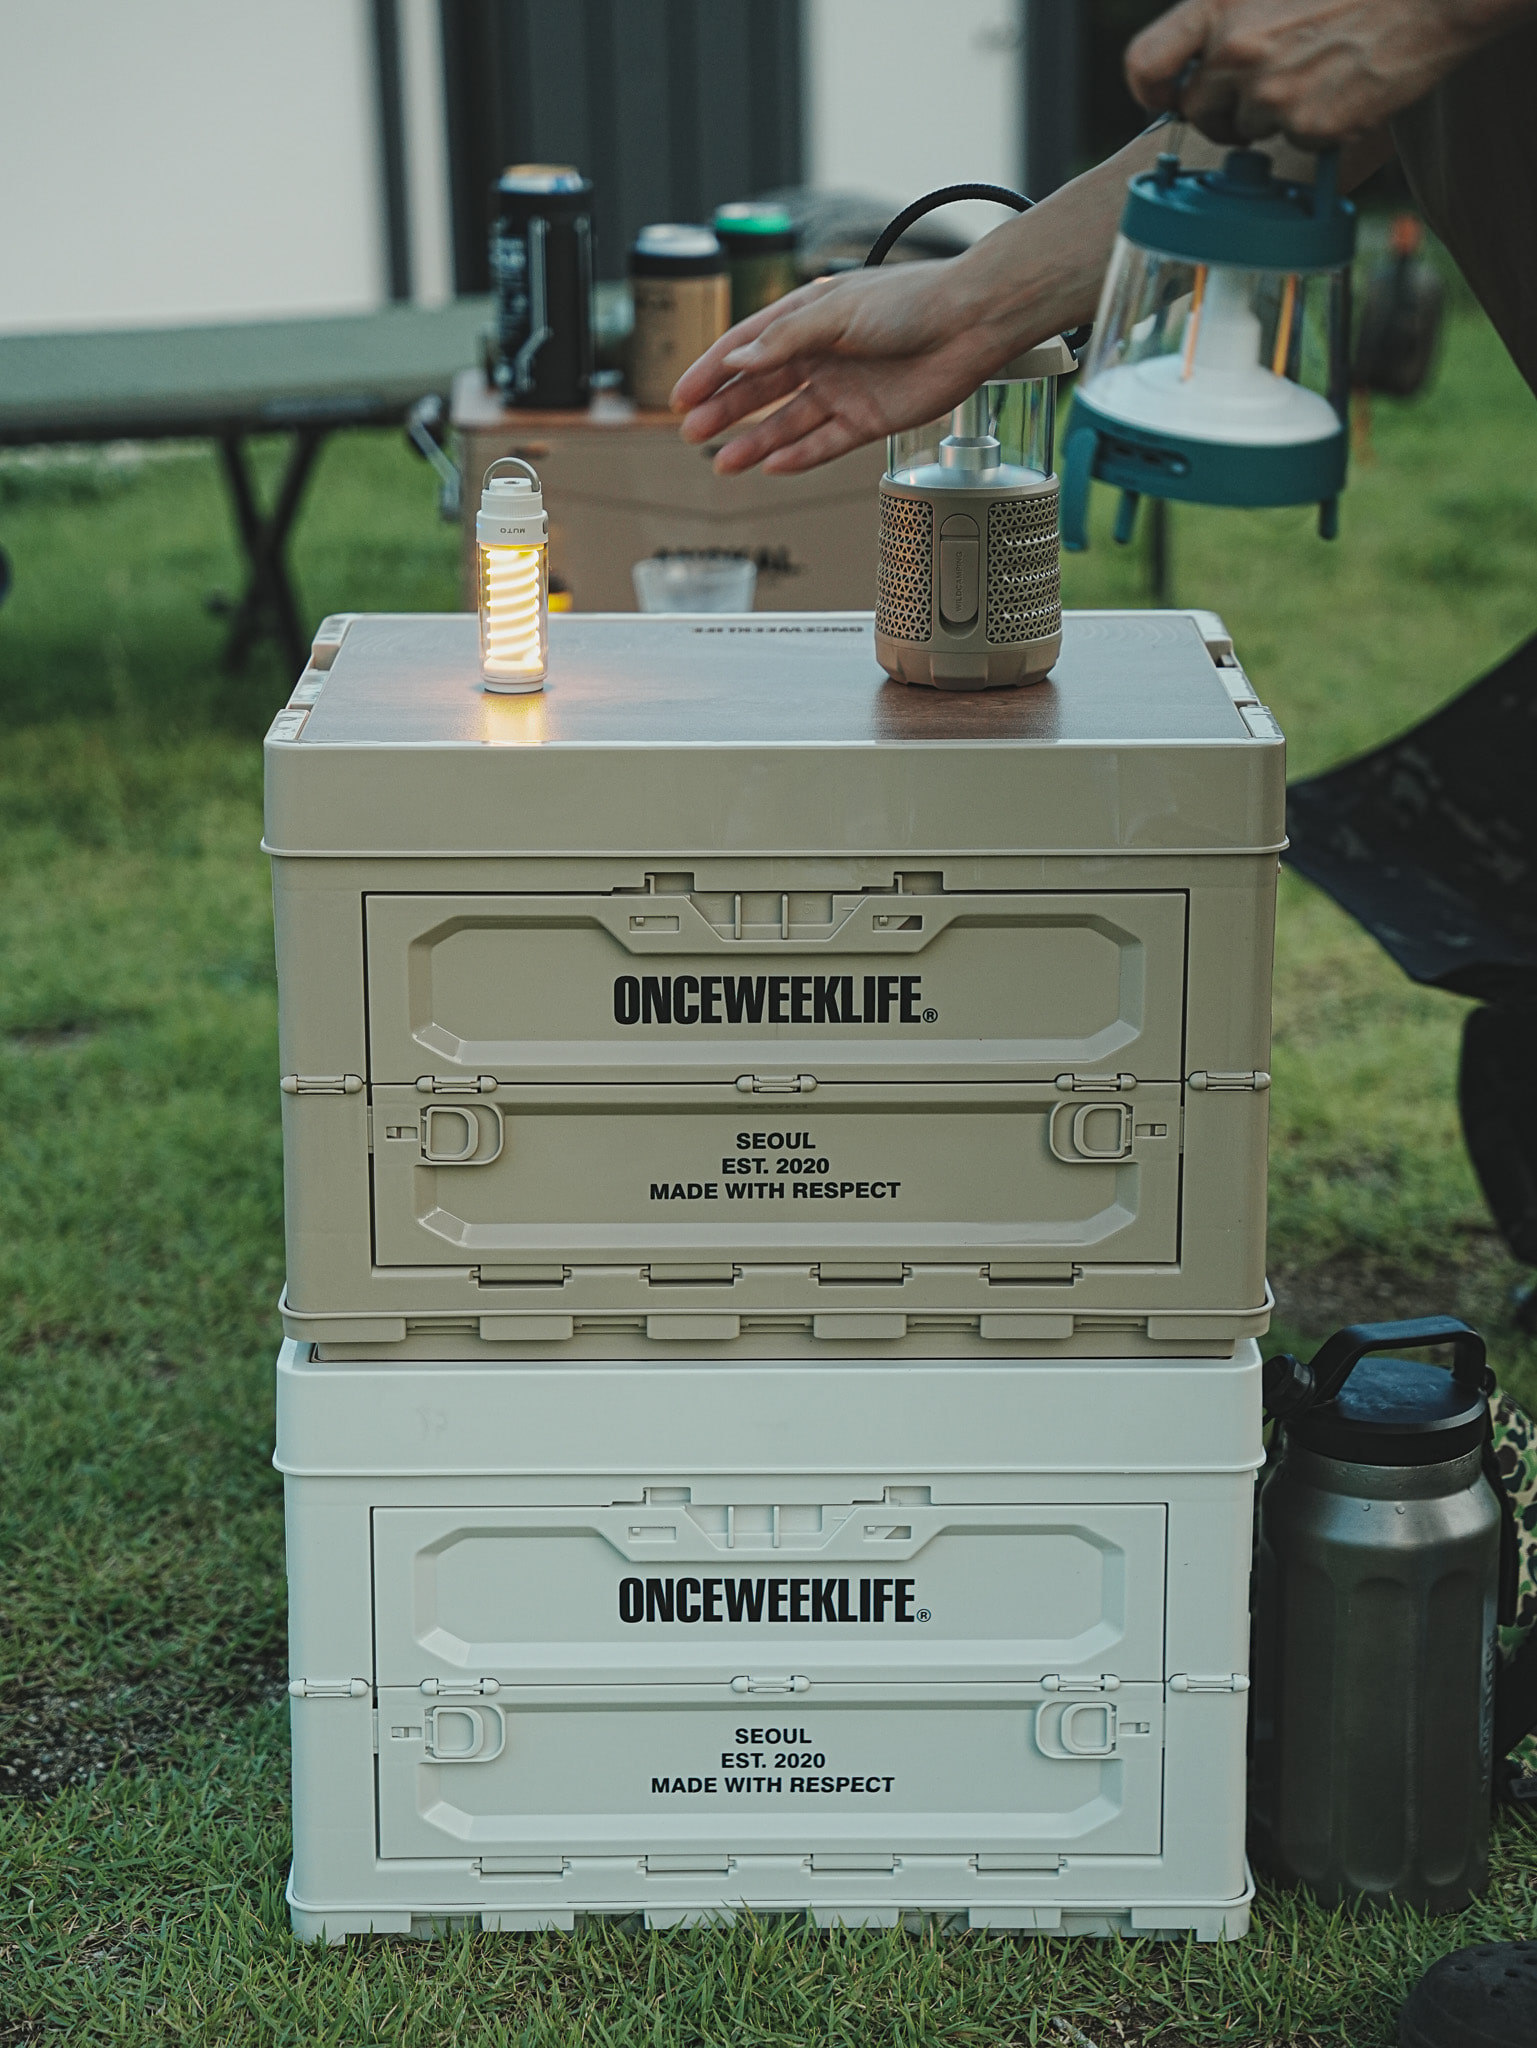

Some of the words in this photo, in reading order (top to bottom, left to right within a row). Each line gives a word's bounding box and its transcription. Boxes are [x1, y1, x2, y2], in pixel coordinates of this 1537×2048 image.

[954, 550, 963, 613] WILDCAMPING
[736, 1132, 816, 1150] SEOUL
[722, 1157, 769, 1175] EST.
[776, 1157, 830, 1175] 2020
[650, 1182, 719, 1200] MADE
[725, 1182, 785, 1200] WITH
[792, 1181, 902, 1199] RESPECT
[735, 1728, 812, 1745] SEOUL
[721, 1752, 767, 1769] EST.
[774, 1752, 826, 1769] 2020
[651, 1777, 718, 1794] MADE
[724, 1777, 782, 1794] WITH
[789, 1776, 895, 1793] RESPECT
